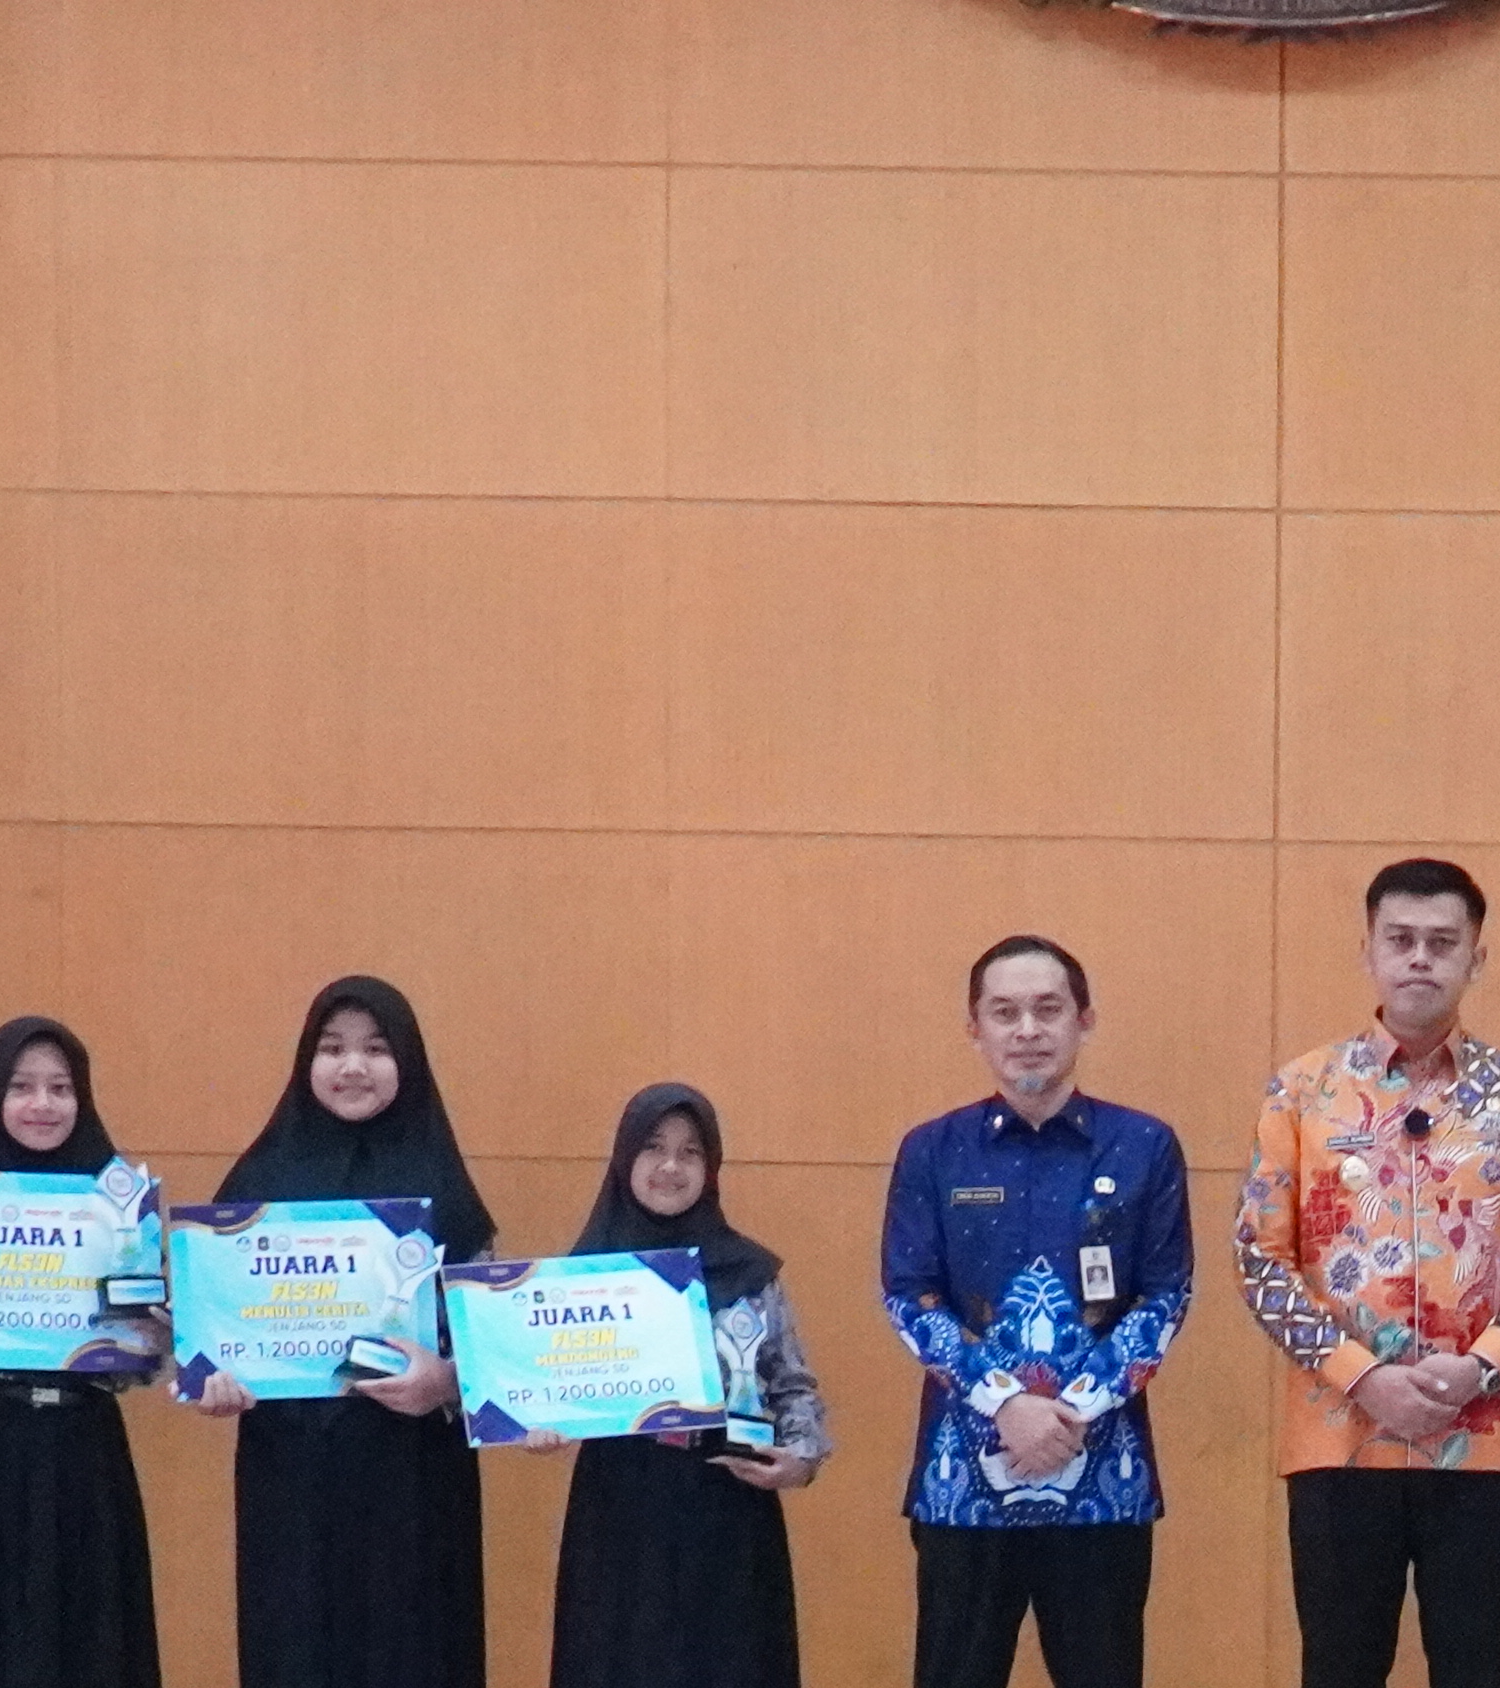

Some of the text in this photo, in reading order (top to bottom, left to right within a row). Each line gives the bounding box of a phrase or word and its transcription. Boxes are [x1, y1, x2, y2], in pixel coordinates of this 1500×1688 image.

[74, 1229, 84, 1247] 1
[249, 1254, 357, 1276] JUARA 1
[528, 1303, 634, 1326] JUARA 1
[220, 1342, 248, 1358] RP.
[507, 1377, 676, 1405] RP. 1.200.000,00
